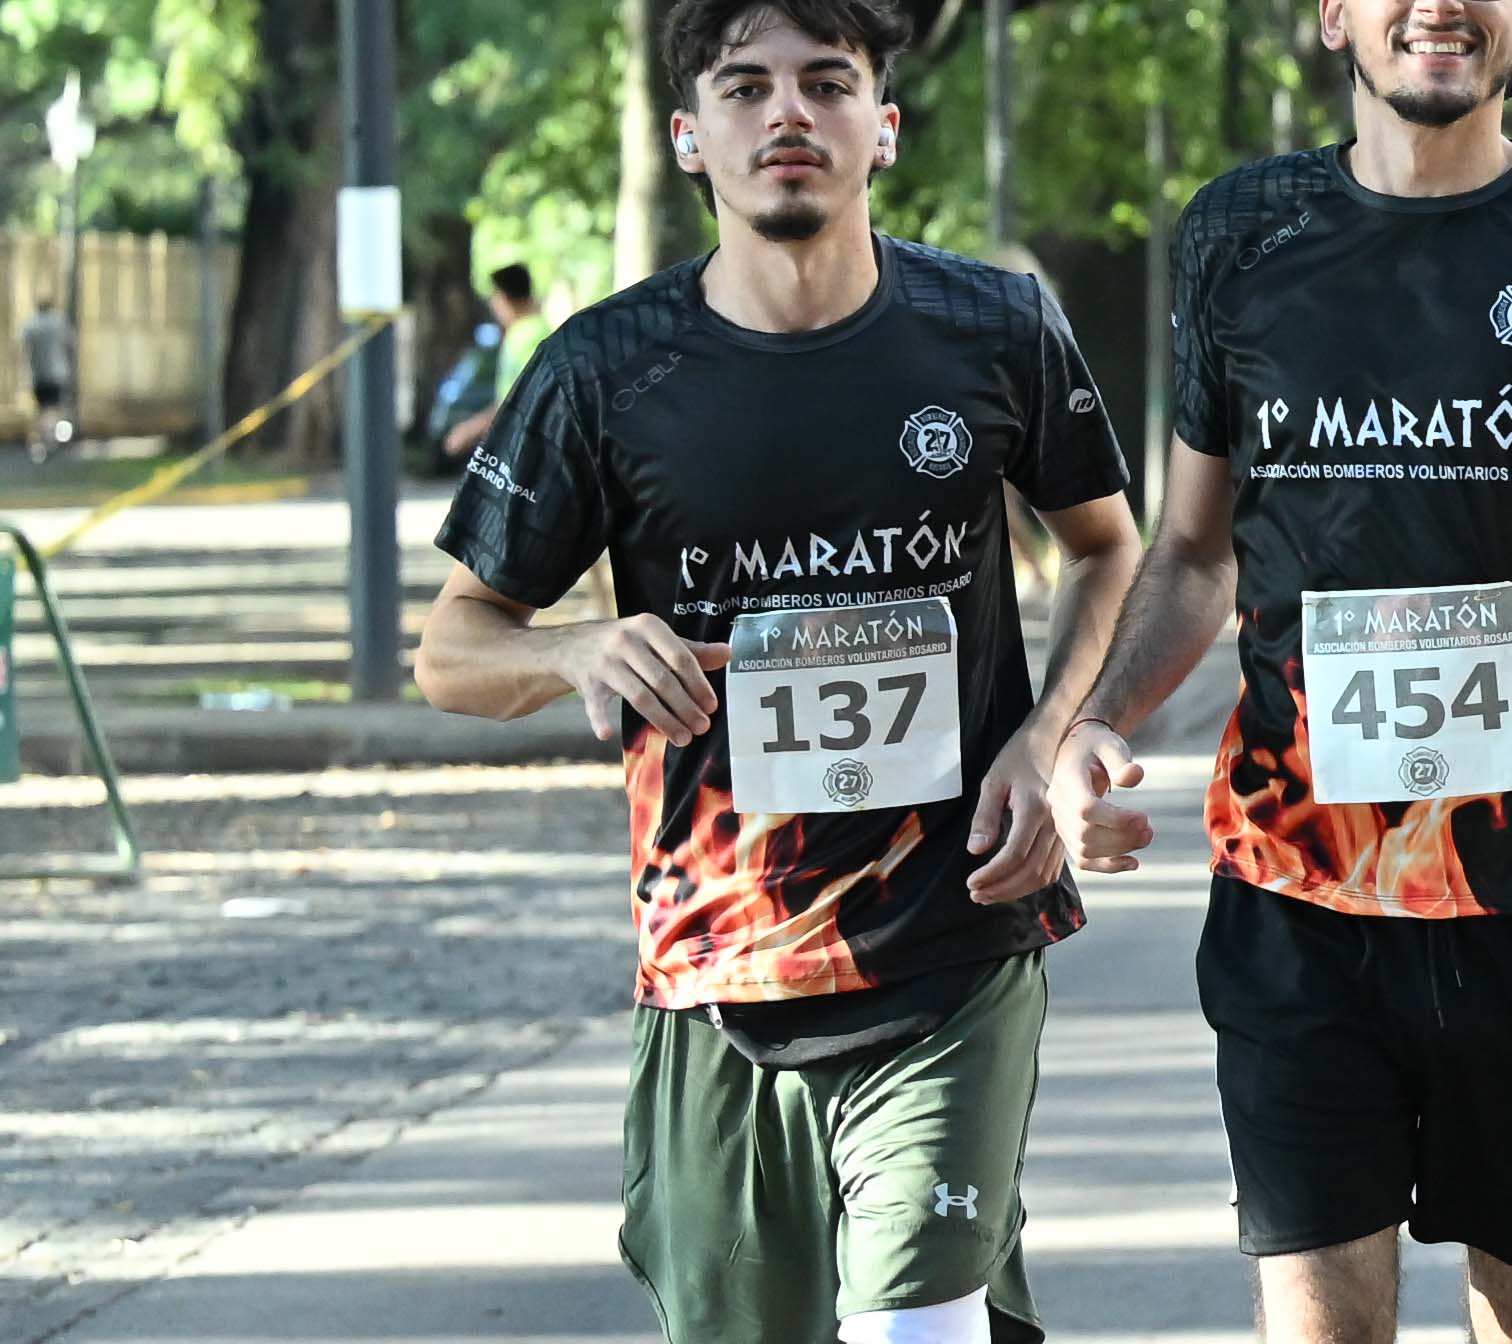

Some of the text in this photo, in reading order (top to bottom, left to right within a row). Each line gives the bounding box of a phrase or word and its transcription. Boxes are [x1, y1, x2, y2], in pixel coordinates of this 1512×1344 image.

[924, 428, 951, 452] 27
[1323, 463, 1404, 479] BOMBEROS
[1409, 463, 1509, 481] VOLUNTARIOS
[732, 510, 969, 583] MARATÓN
[741, 592, 823, 610] BOMBEROS
[826, 585, 925, 606] VOLUNTARIOS
[929, 571, 972, 597] ROSARIO
[792, 610, 924, 651] MARATÓN
[1364, 595, 1498, 635] MARATÓN
[847, 647, 907, 663] VOLUNTARIOS
[909, 642, 947, 655] ROSARIO
[1419, 633, 1482, 650] VOLUNTARIOS
[759, 672, 927, 753] 137
[1331, 662, 1509, 740] 454
[839, 773, 858, 790] 27
[1415, 762, 1433, 779] 27
